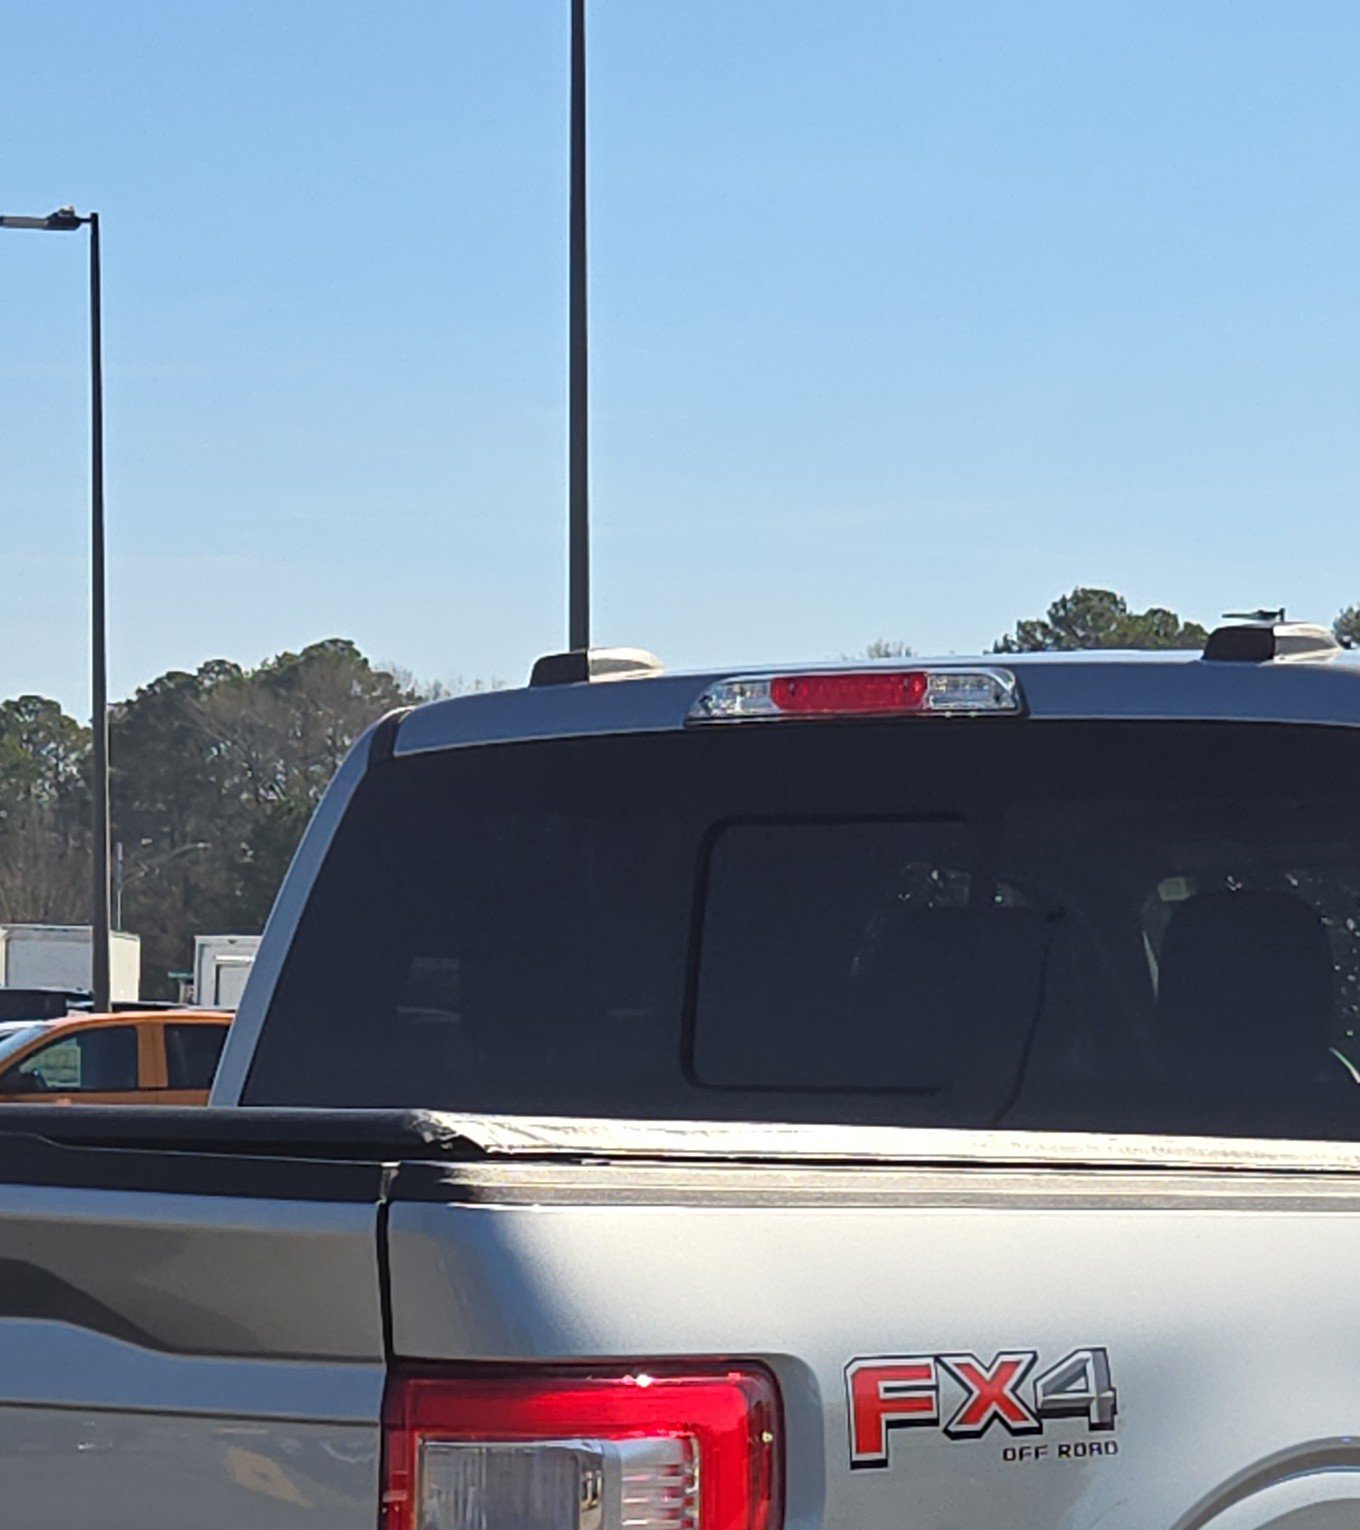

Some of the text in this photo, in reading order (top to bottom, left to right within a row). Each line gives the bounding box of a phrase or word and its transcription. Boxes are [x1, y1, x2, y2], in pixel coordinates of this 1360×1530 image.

[844, 1347, 1118, 1470] FX4
[1002, 1441, 1119, 1462] OFF ROAD
